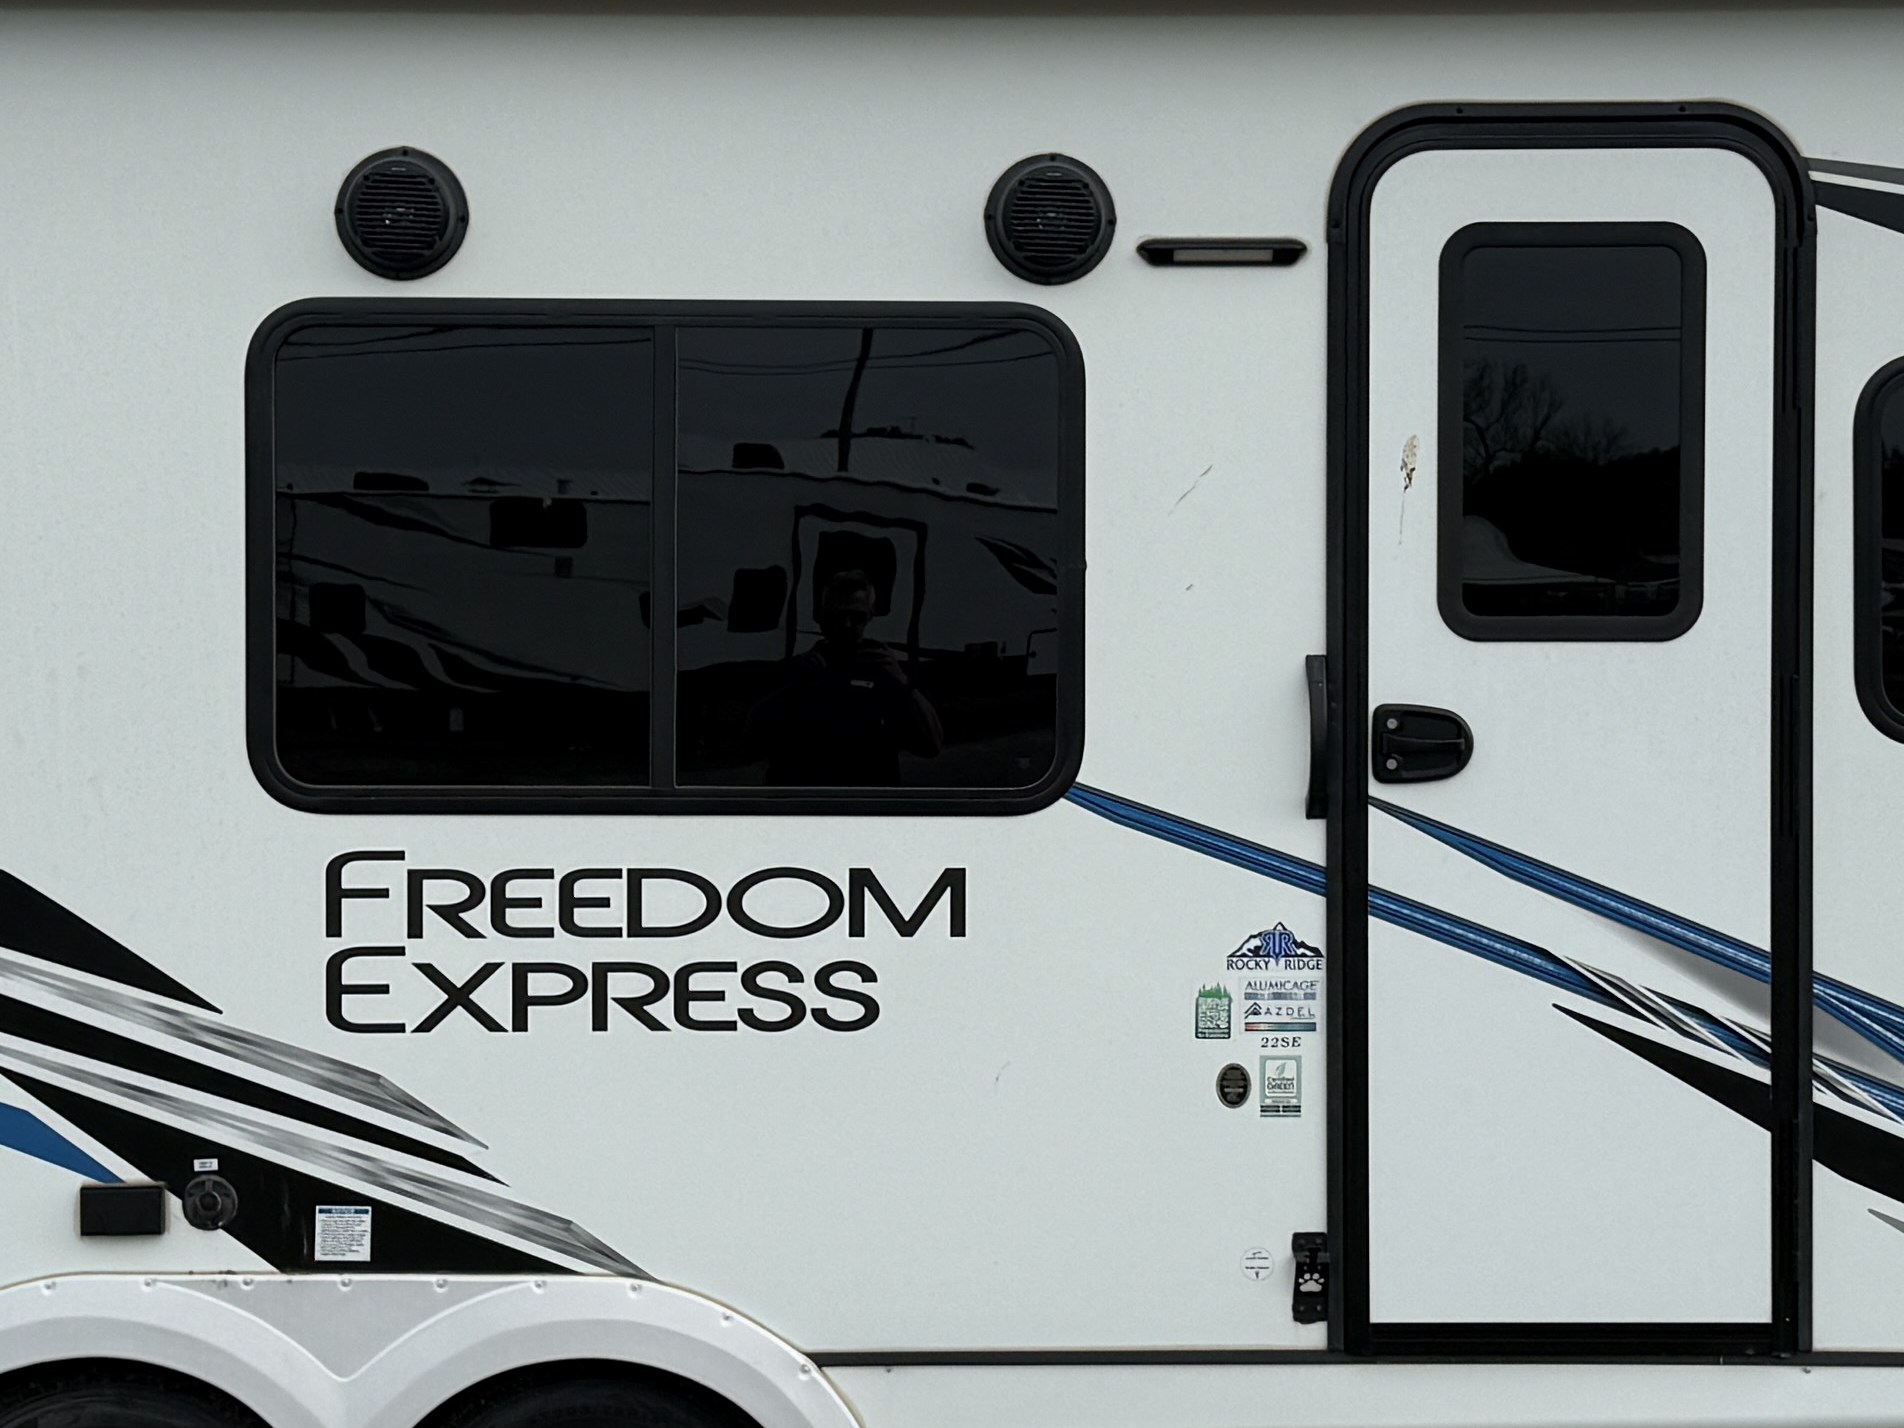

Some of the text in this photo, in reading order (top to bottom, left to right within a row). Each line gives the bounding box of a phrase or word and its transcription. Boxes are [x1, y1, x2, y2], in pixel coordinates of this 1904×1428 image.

[325, 849, 967, 940] FREEDOM
[325, 945, 881, 1034] EXPRESS
[1226, 959, 1324, 971] ROCKY RIDGE
[1260, 1036, 1302, 1048] 22SE
